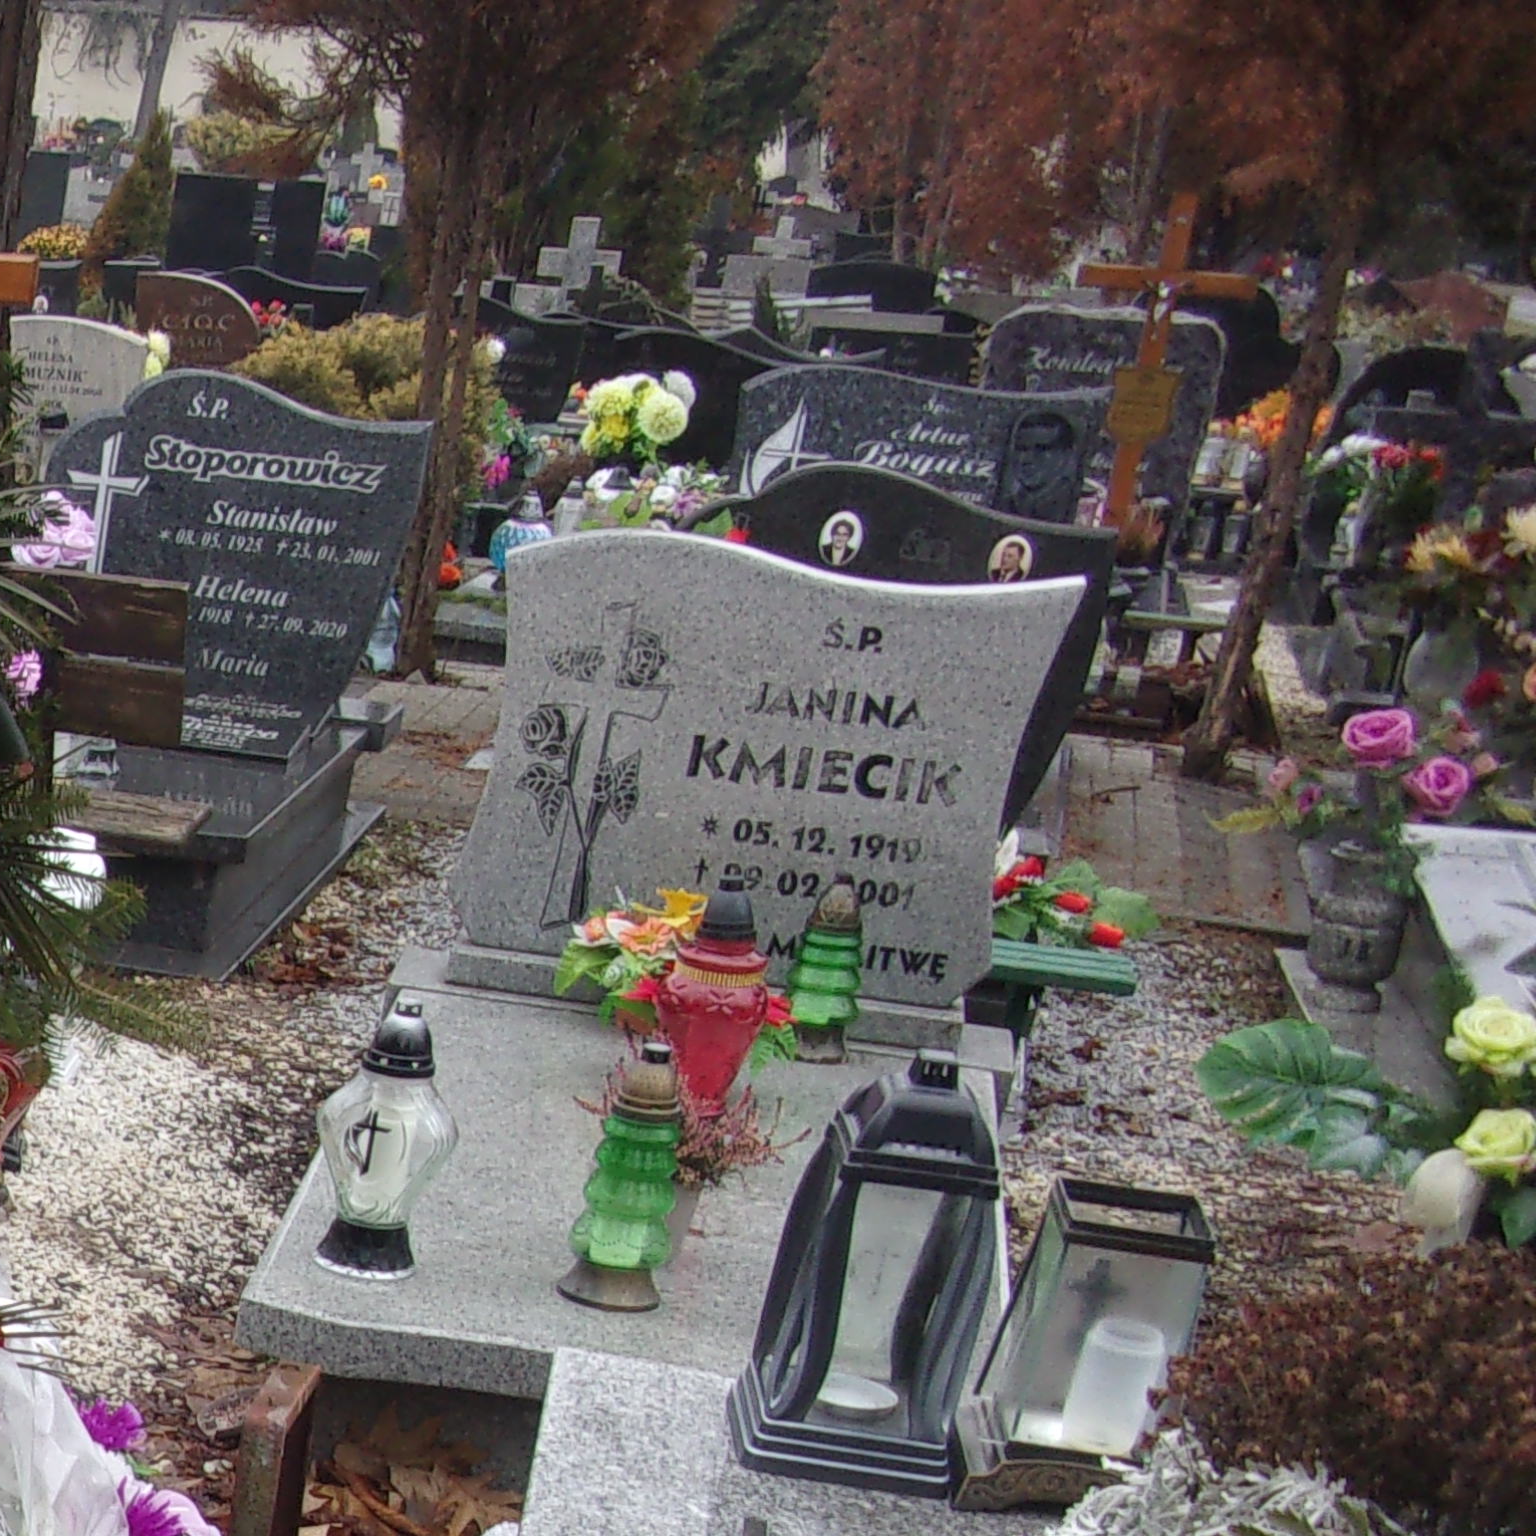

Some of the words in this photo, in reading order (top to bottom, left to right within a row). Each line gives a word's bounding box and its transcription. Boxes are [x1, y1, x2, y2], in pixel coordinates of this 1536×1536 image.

[890, 421, 971, 446] Artur
[145, 433, 388, 495] Stoporowicz
[206, 499, 338, 536] Stanisław
[194, 574, 290, 609] Helena
[309, 620, 348, 640] 2020
[194, 648, 271, 679] Maria
[744, 681, 928, 732] JANINA
[685, 733, 963, 808] KMIECIK
[848, 878, 915, 911] 001
